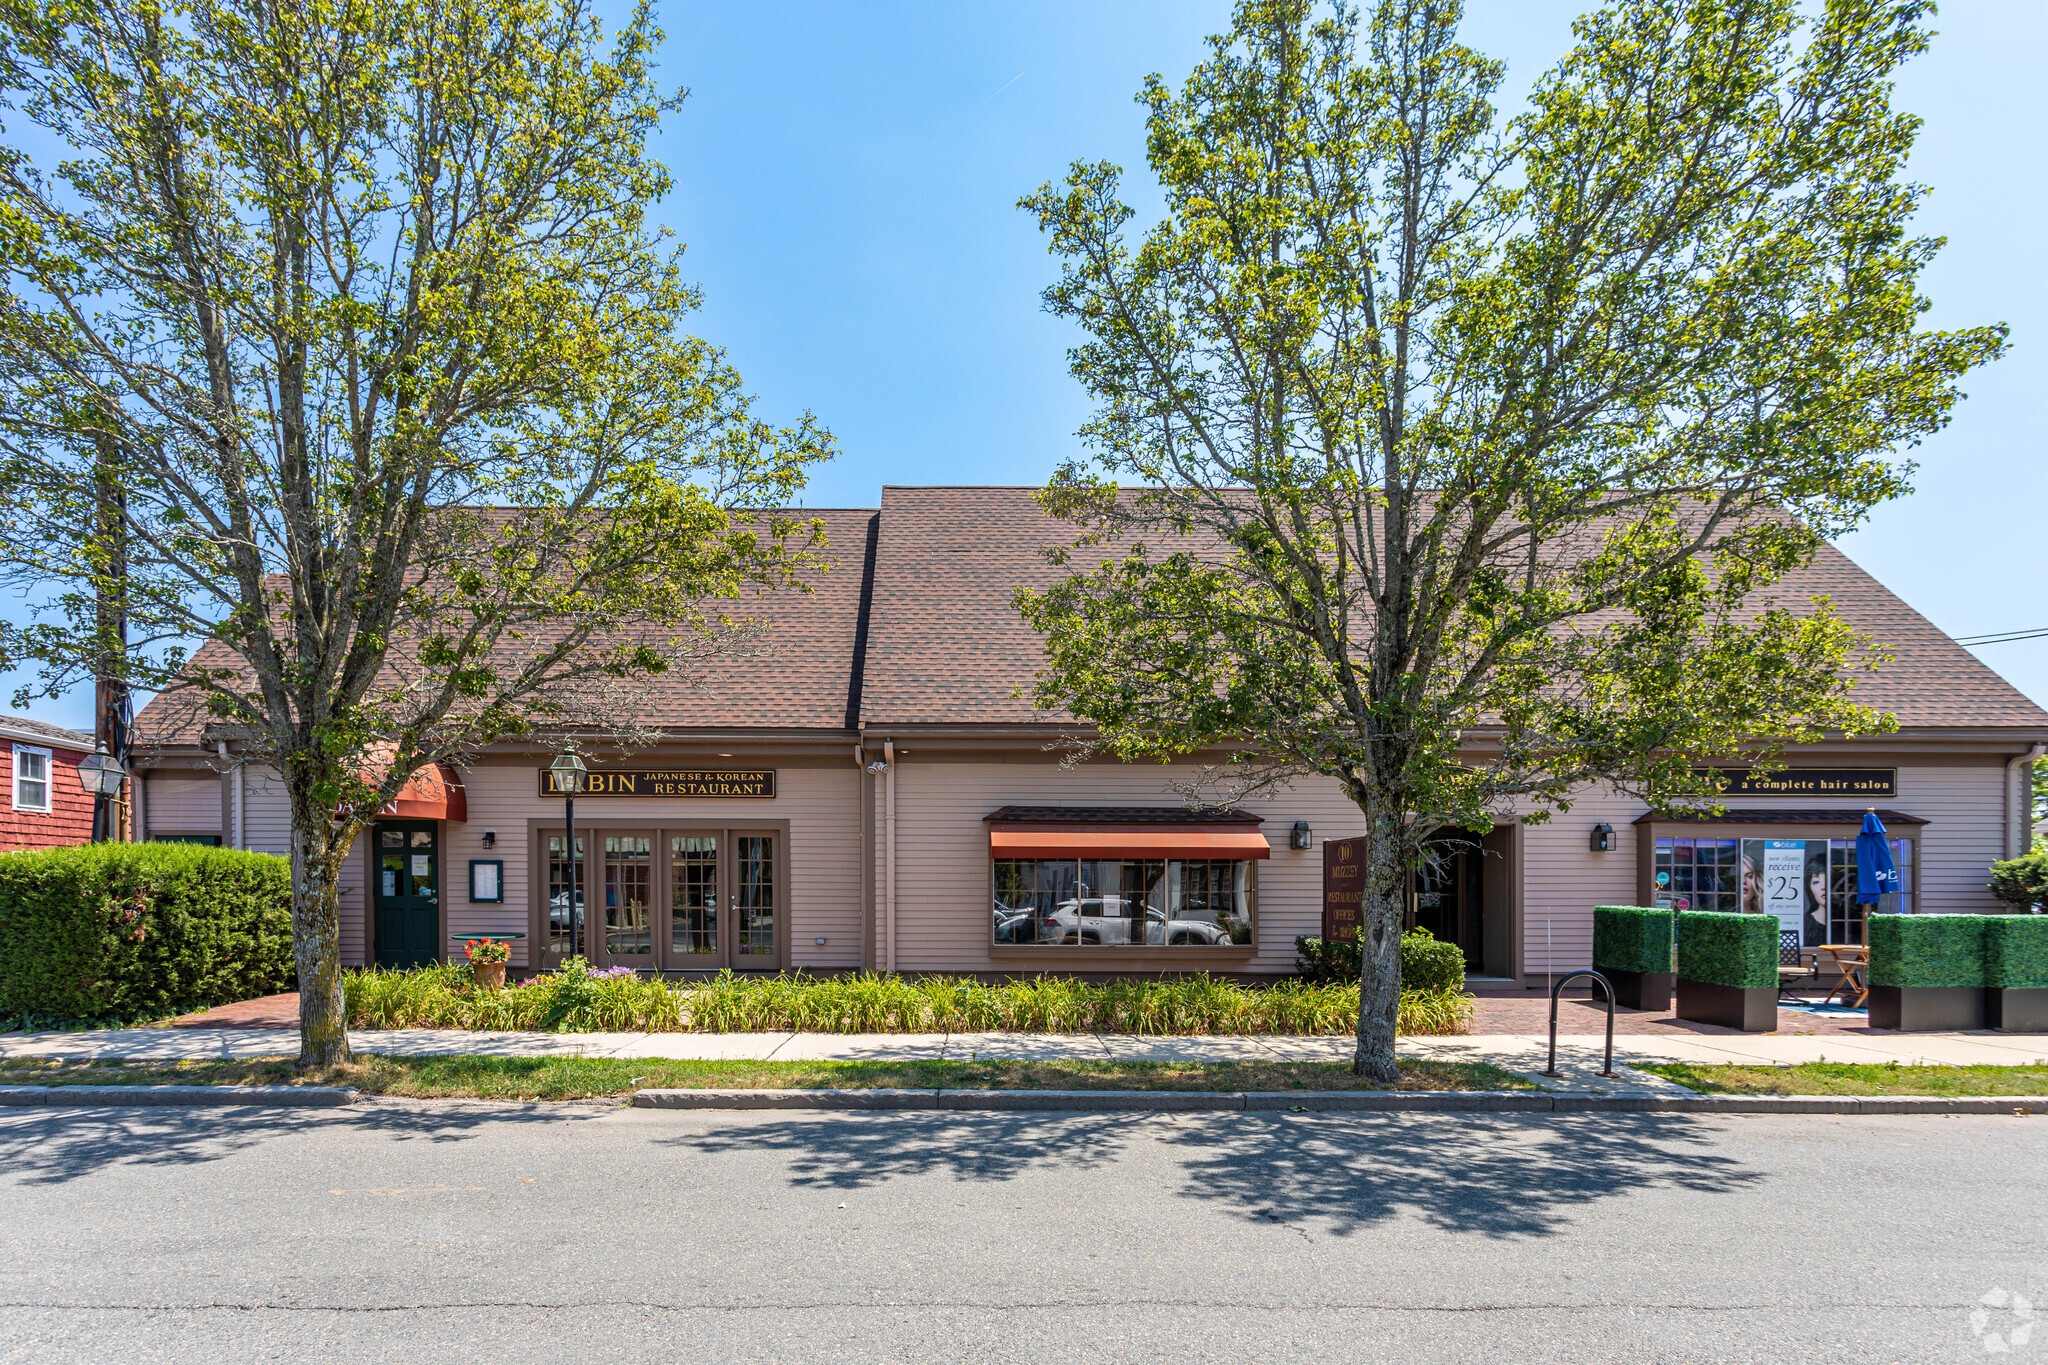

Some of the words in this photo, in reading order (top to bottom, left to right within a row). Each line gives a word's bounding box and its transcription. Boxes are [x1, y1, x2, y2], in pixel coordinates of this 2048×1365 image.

[548, 774, 636, 793] BIN
[643, 773, 702, 781] JAPANESE
[705, 773, 714, 781] &
[716, 773, 764, 782] KOREAN
[654, 783, 764, 794] RESTAURANT
[1741, 781, 1748, 789] a
[1755, 779, 1815, 791] complete
[1820, 779, 1849, 789] hair
[1854, 779, 1889, 789] salon
[1780, 841, 1797, 849] blue
[1341, 845, 1350, 861] 10
[1332, 864, 1359, 879] MUZZEY
[1768, 862, 1801, 871] receive
[1767, 876, 1801, 901] $25
[1327, 891, 1363, 903] RESTAURANT
[1333, 909, 1355, 921] OFFICES
